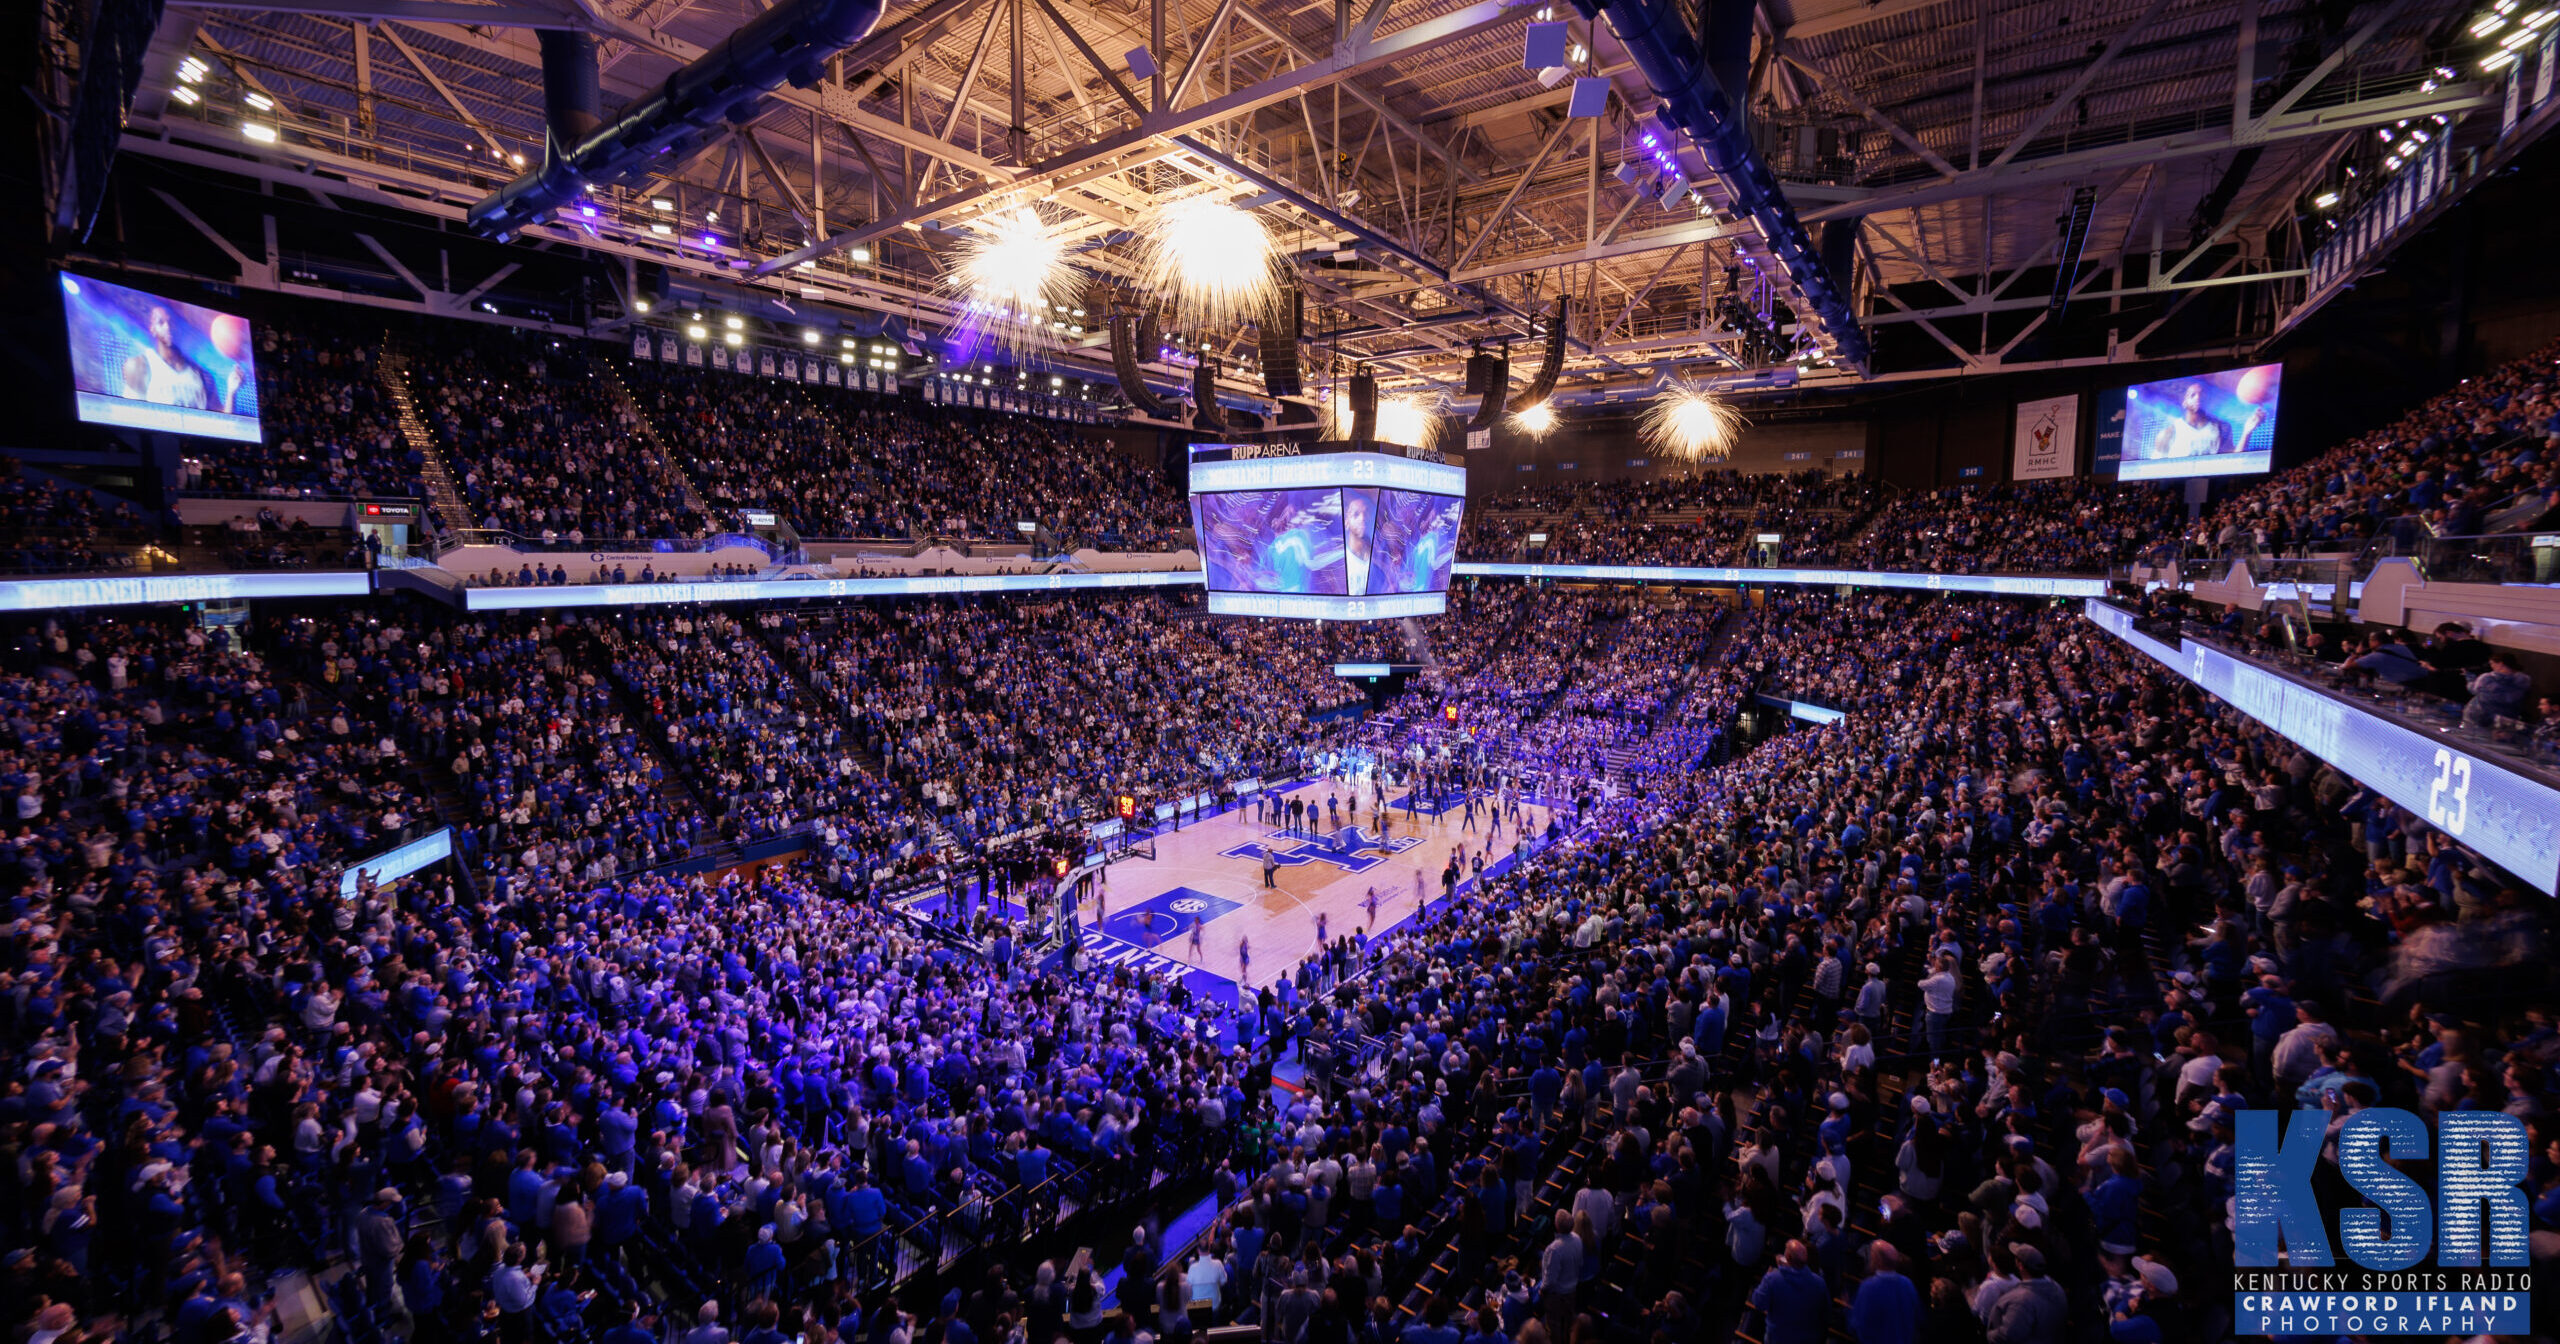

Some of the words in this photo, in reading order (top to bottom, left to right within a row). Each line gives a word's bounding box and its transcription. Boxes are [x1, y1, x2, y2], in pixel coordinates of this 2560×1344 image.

[2028, 457, 2057, 466] RMHC
[1353, 460, 1374, 479] 23
[1049, 576, 1061, 588] 23
[1725, 570, 1740, 582] 23
[830, 581, 846, 595] 23
[1348, 601, 1365, 617] 23
[2428, 748, 2471, 836] 23
[1121, 806, 1132, 815] 30
[1104, 824, 1113, 834] 23
